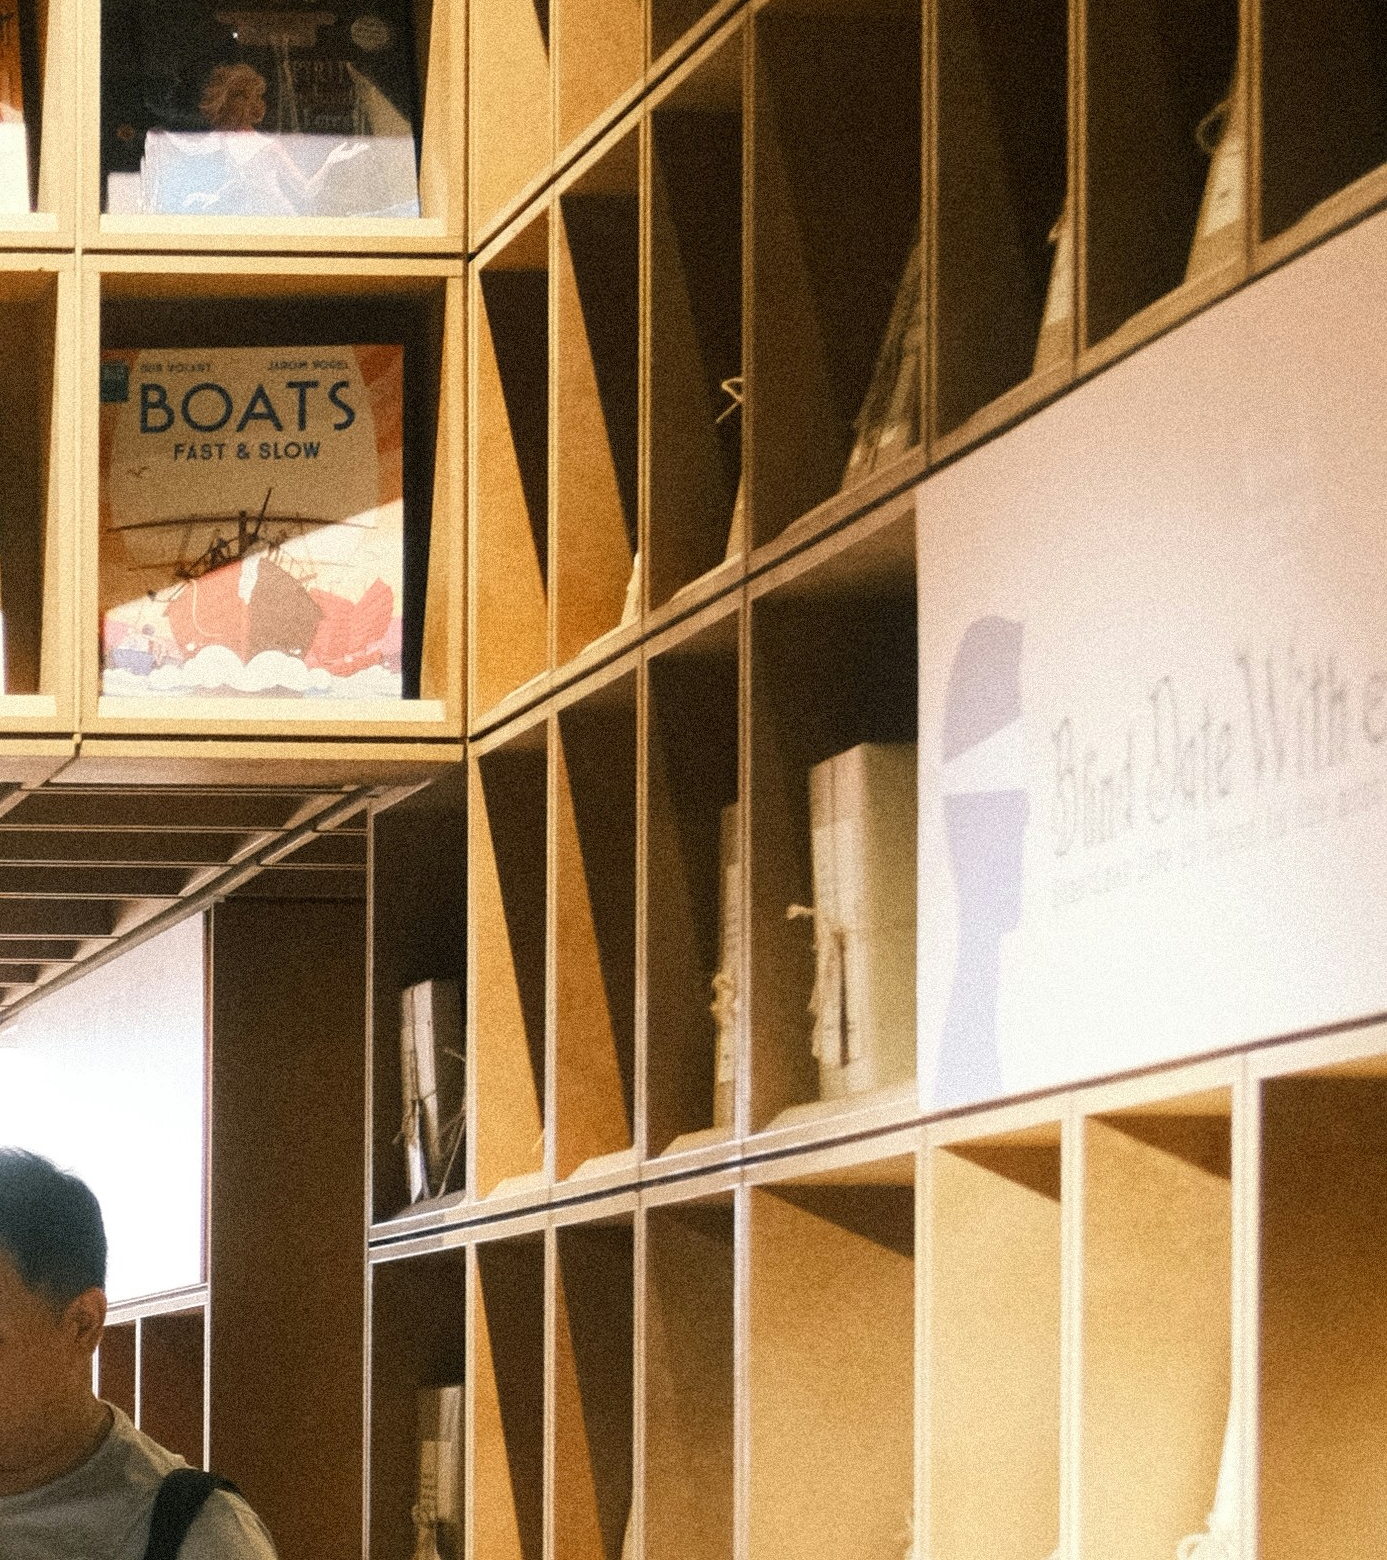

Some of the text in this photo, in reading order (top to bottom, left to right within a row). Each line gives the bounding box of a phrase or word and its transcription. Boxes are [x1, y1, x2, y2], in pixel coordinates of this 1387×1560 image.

[139, 379, 357, 434] BOATS
[173, 440, 321, 462] FAST & SLOW
[1050, 711, 1135, 860] Blind
[1145, 670, 1233, 826] Date
[1233, 636, 1349, 790] With
